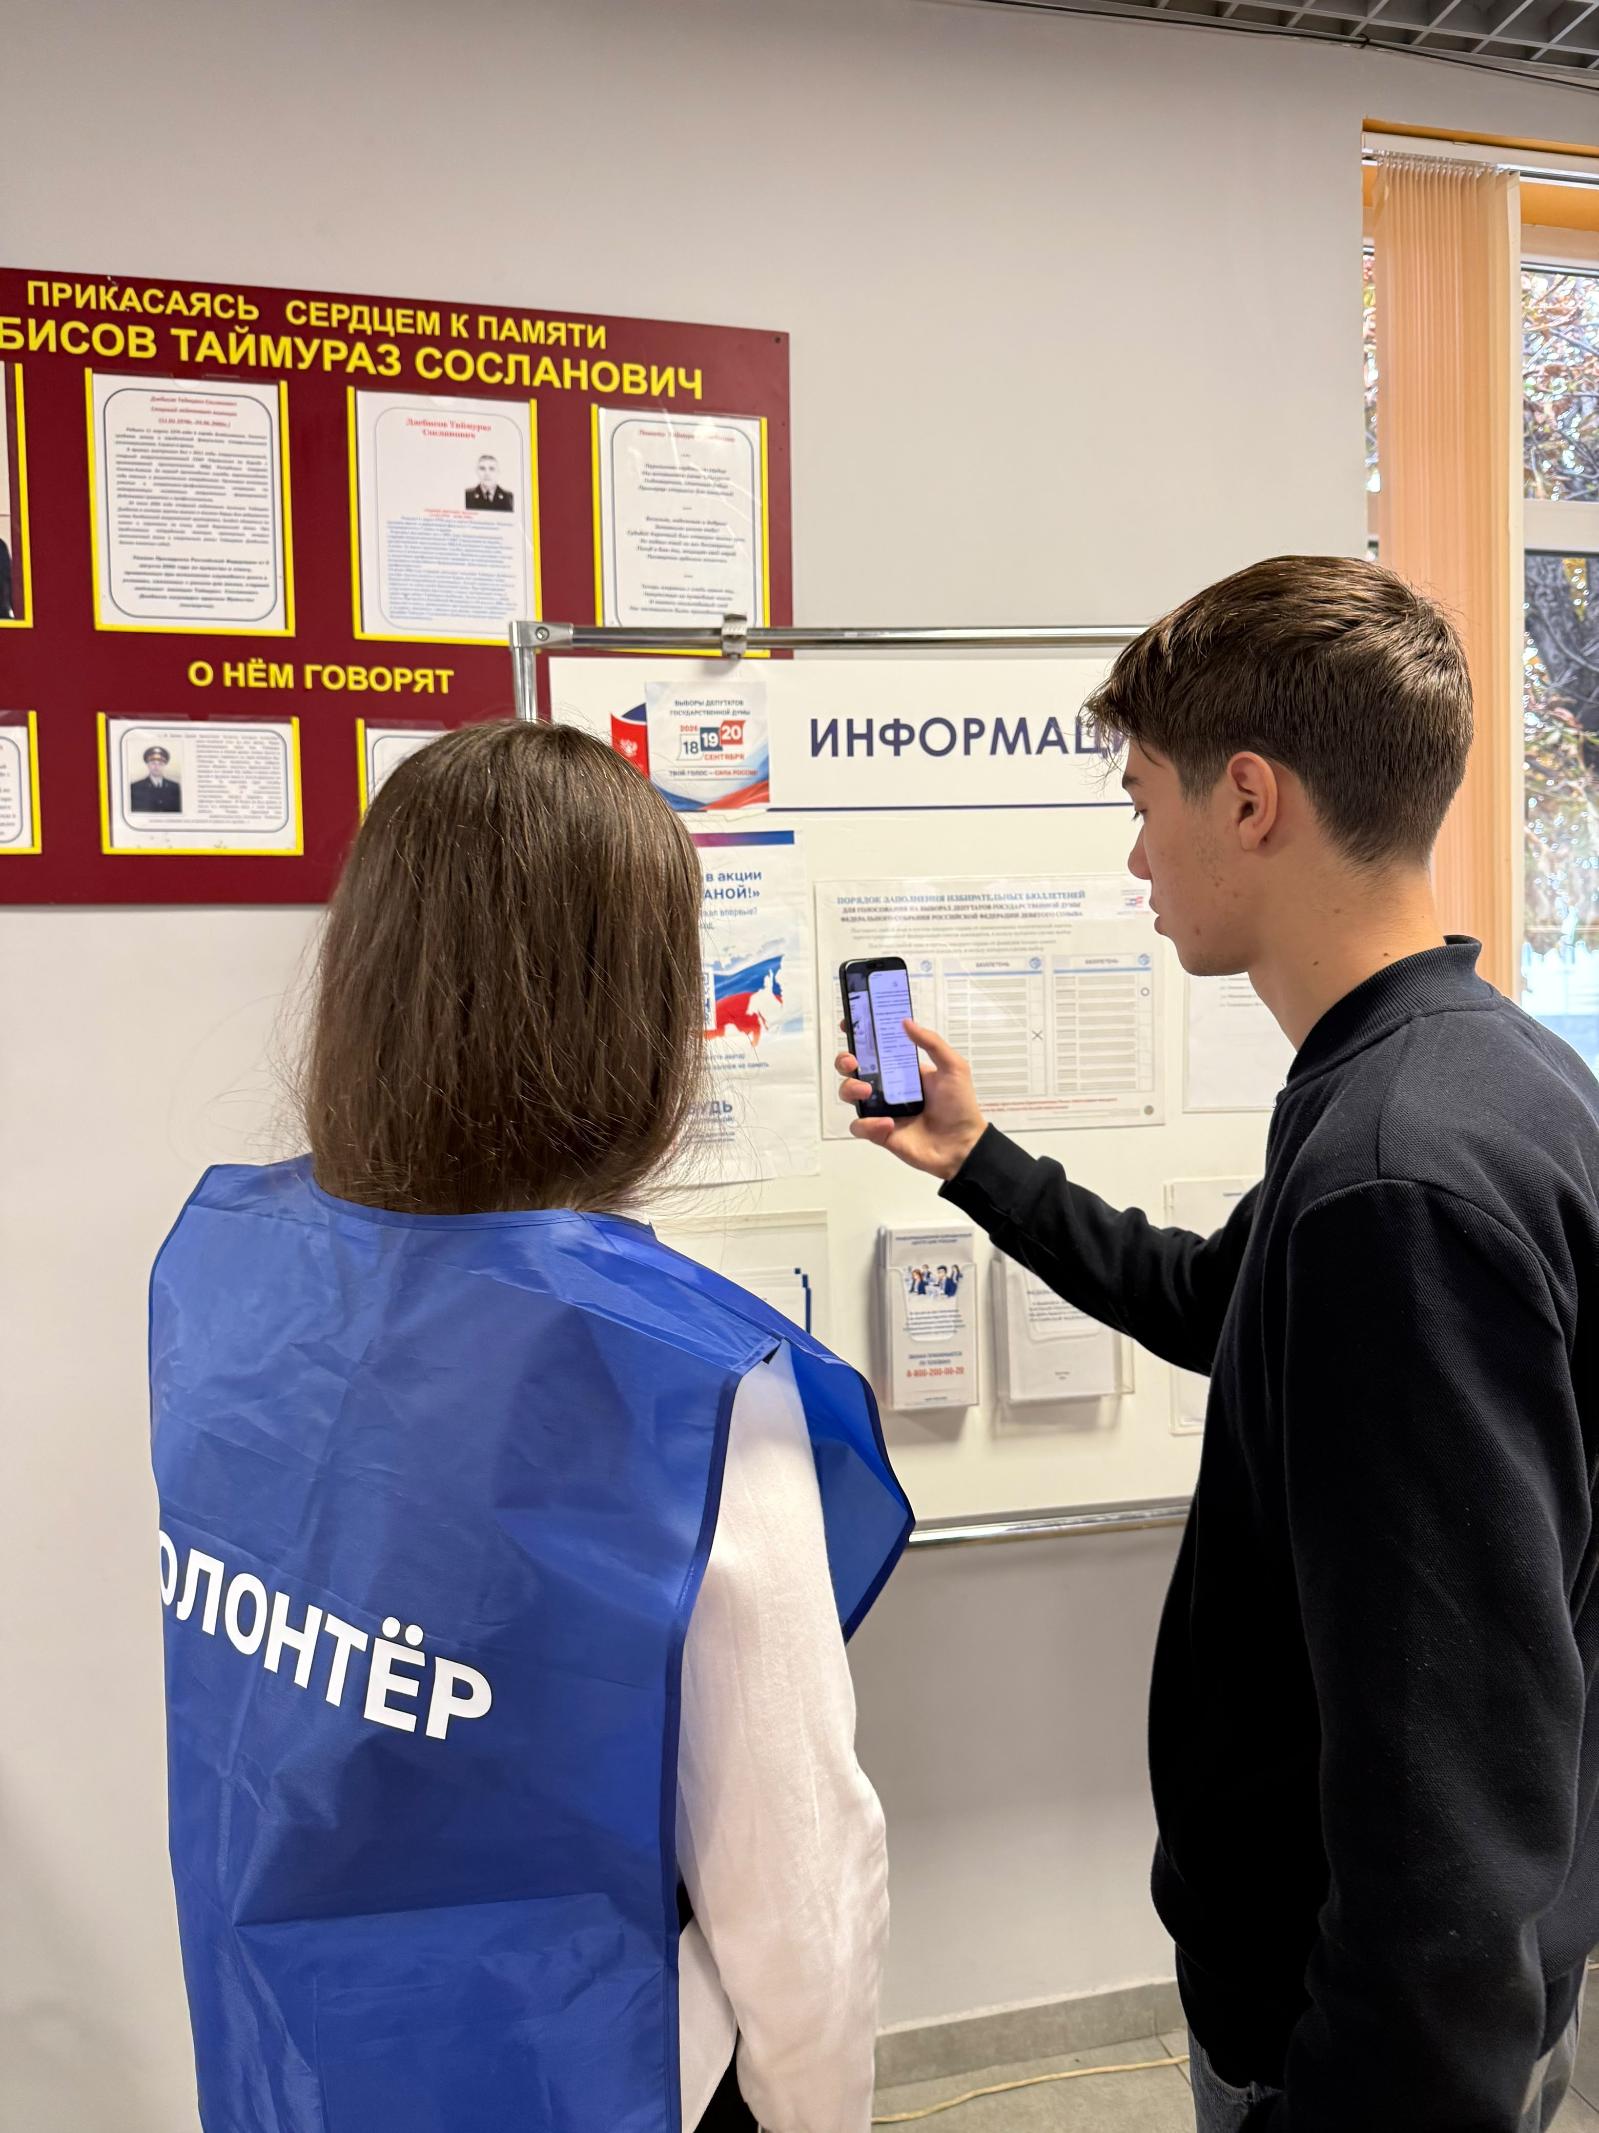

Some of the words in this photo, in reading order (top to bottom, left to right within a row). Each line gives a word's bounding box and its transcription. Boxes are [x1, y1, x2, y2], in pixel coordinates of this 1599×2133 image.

[27, 280, 259, 321] ПРИКАСАЯСЬ
[285, 300, 441, 337] СЕРДЦЕМ
[450, 312, 469, 339] К
[478, 314, 607, 350] ПАМЯТИ
[0, 316, 158, 359] БИСОВ
[170, 325, 402, 377] ТАЙМУРАЗ
[415, 347, 703, 400] СОСЛАНОВИЧ
[188, 661, 214, 687] О
[223, 657, 295, 689] НЁМ
[304, 664, 455, 694] ГОВОРЯТ
[683, 740, 699, 755] 18
[701, 732, 719, 748] 19
[721, 725, 742, 740] 20
[811, 716, 1125, 759] ИНФОРМАЦ
[704, 753, 745, 761] СЕНТЯБРЯ
[704, 884, 760, 900] АНОЙ!»
[705, 873, 714, 882] в
[718, 871, 762, 882] акции
[158, 1529, 492, 1740] ОЛОНТЁР
